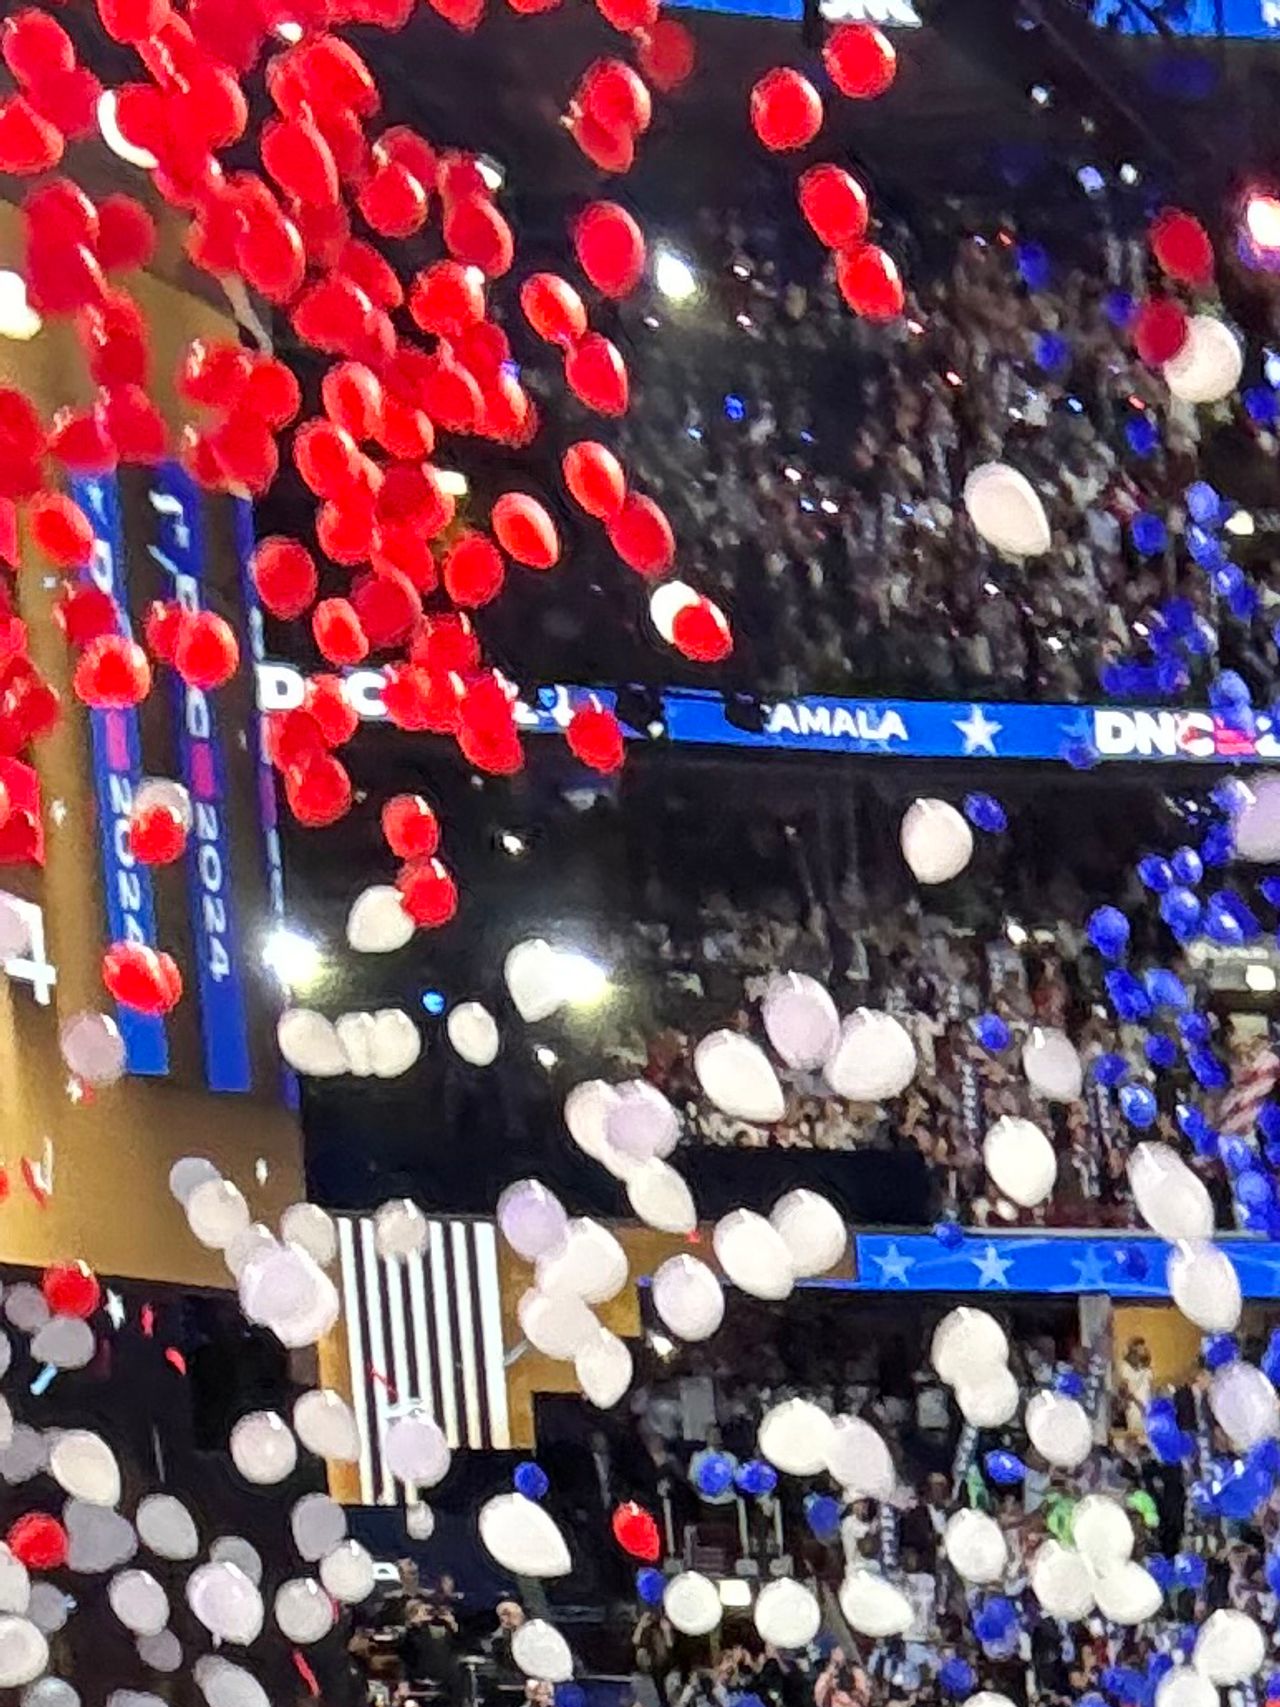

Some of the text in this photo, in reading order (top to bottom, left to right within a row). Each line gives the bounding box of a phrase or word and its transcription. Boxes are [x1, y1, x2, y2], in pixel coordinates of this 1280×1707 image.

[257, 666, 388, 717] DC
[762, 702, 908, 741] AMALA
[1095, 709, 1215, 757] DNC
